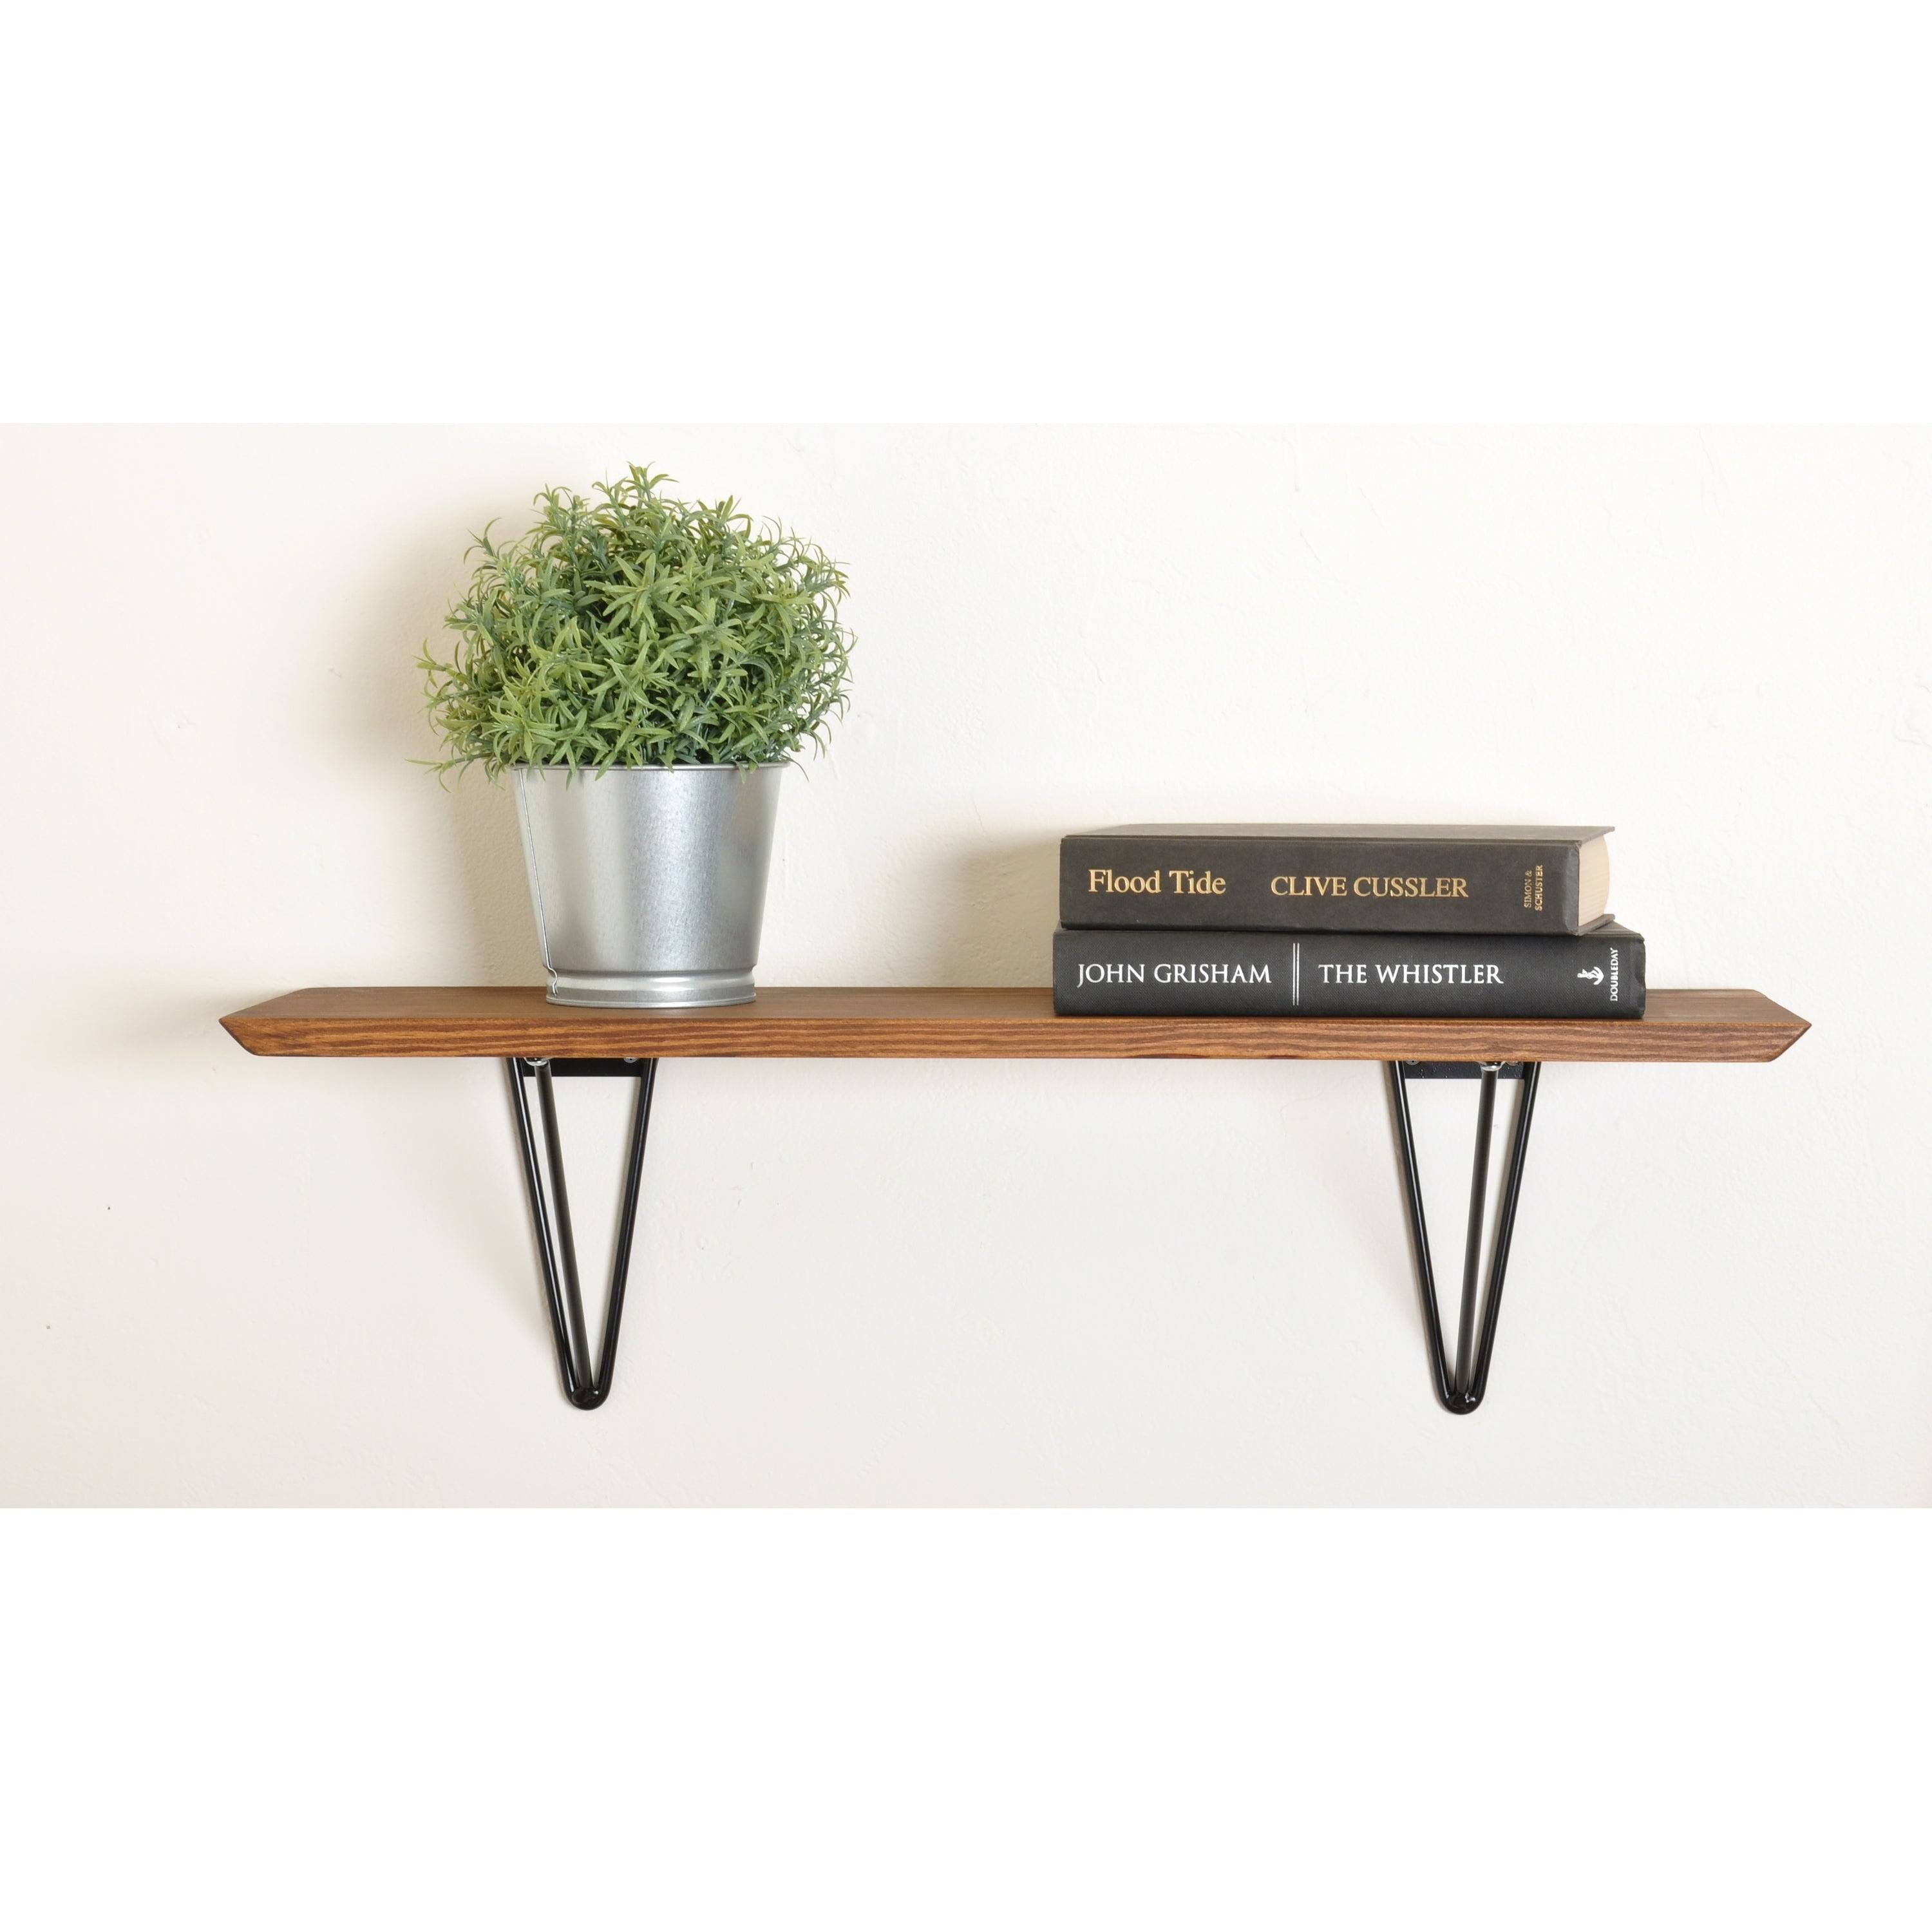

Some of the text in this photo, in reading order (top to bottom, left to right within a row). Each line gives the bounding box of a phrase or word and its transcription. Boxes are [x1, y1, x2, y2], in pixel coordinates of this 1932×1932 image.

[1088, 869, 1226, 895] Flood Tide
[1271, 876, 1468, 898] CLIVE CUSSLER
[1524, 879, 1532, 908] SIMON
[1535, 865, 1543, 911] SCHUSTER
[1077, 963, 1272, 988] JOHN GRISHAM
[1318, 964, 1504, 984] THE WHISTLER
[1610, 947, 1618, 1001] DOUBLEDAY
